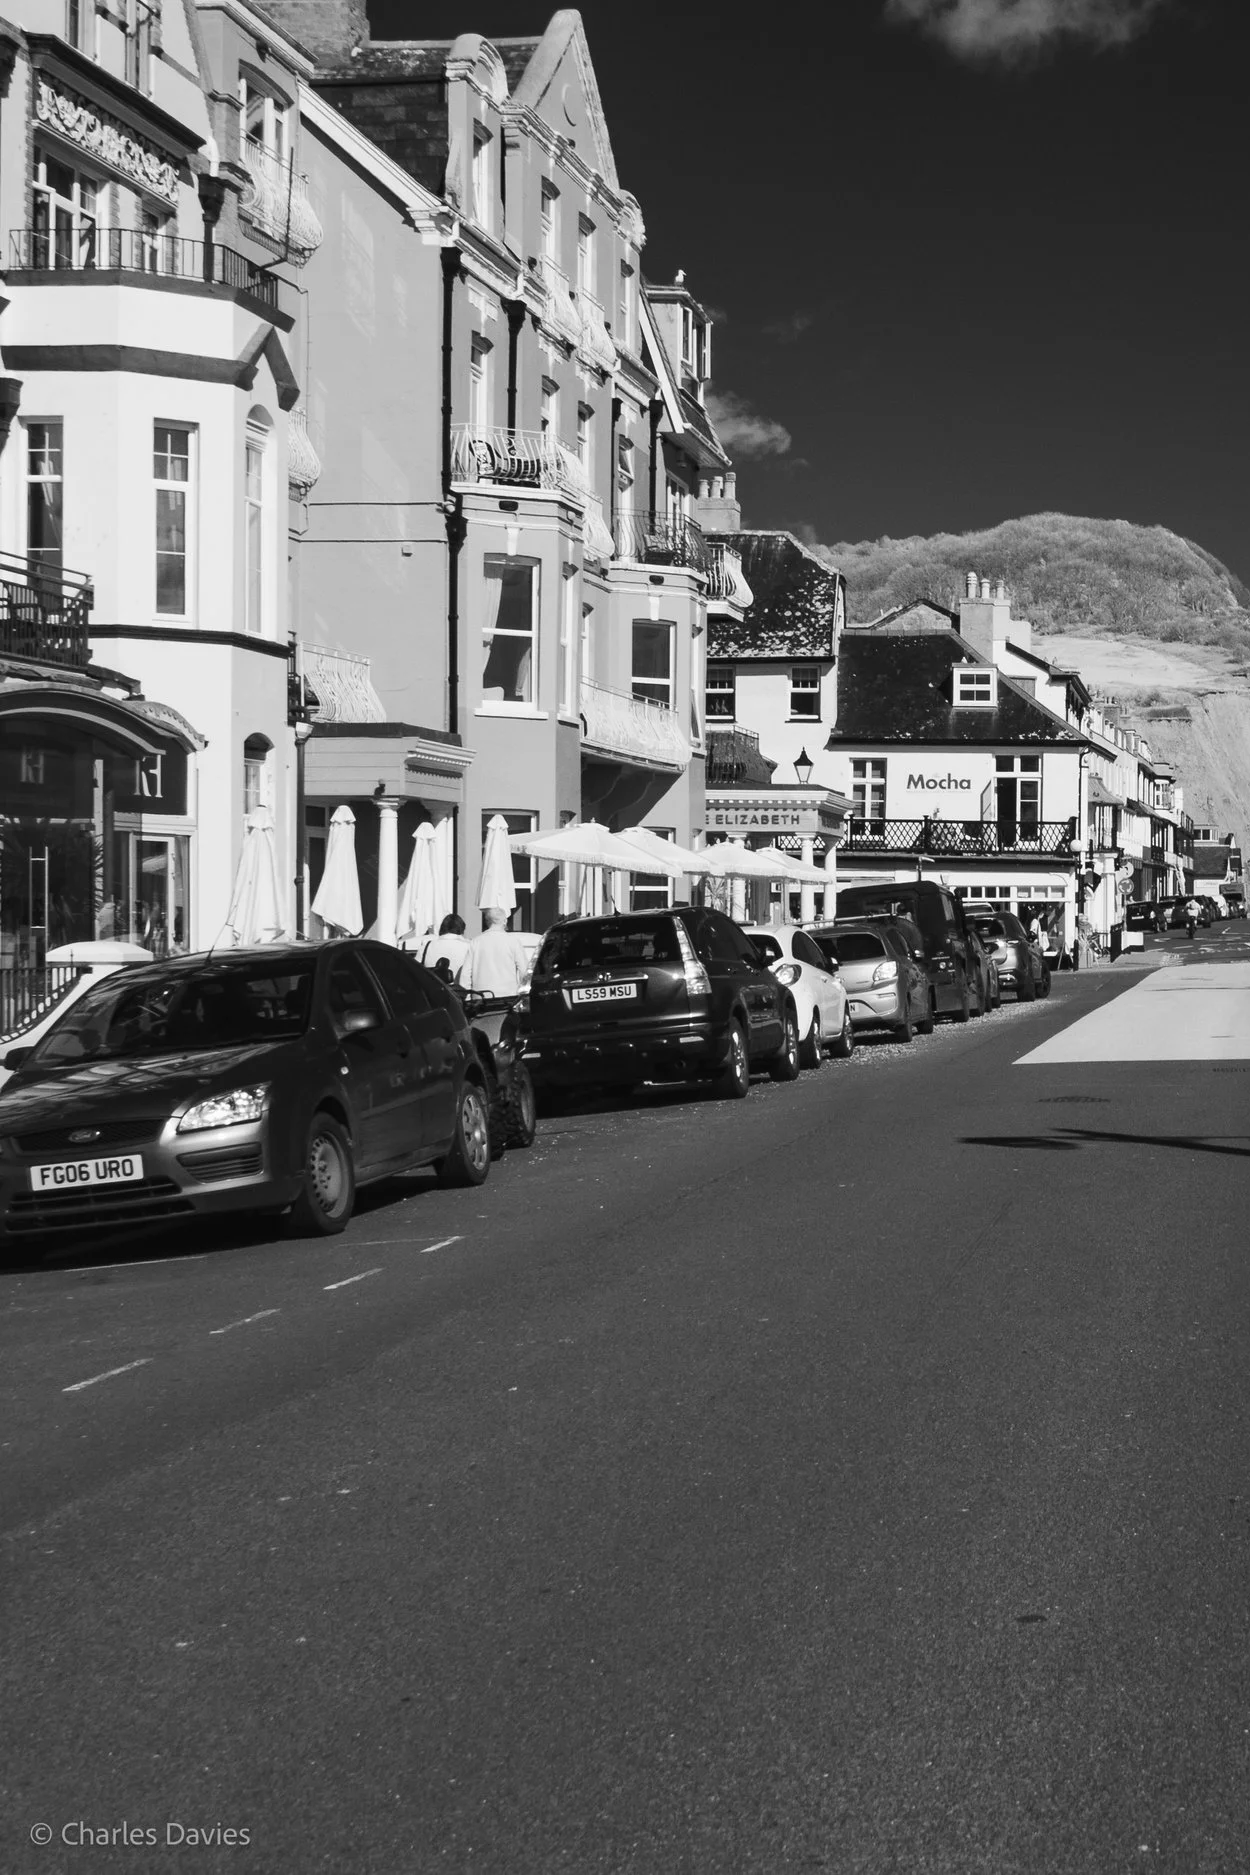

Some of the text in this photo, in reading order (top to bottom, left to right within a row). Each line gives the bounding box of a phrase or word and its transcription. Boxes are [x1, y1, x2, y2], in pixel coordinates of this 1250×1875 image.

[906, 772, 971, 790] Mocha
[715, 814, 800, 825] ELIZABETH
[577, 985, 632, 1001] LS59 MSU
[40, 1158, 134, 1186] FG06 URO
